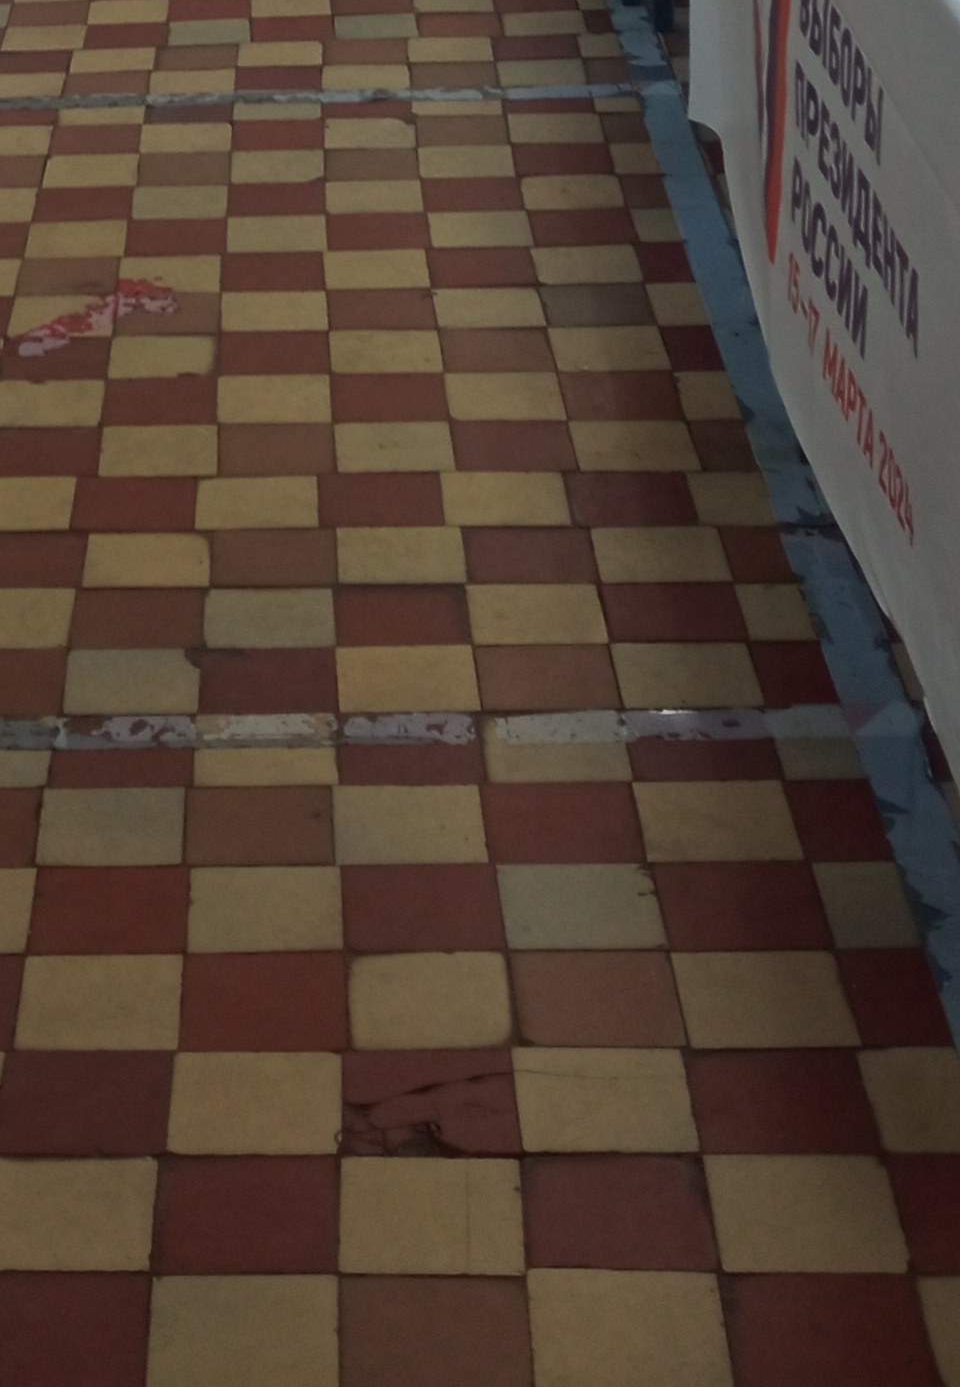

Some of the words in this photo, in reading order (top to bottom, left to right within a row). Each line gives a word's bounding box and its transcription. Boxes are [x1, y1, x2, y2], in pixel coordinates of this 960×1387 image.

[791, 156, 868, 361] РОССИИ
[795, 59, 919, 359] ПРЕЗИДЕНТА
[823, 328, 873, 469] МАРТА
[879, 429, 914, 546] 2024
